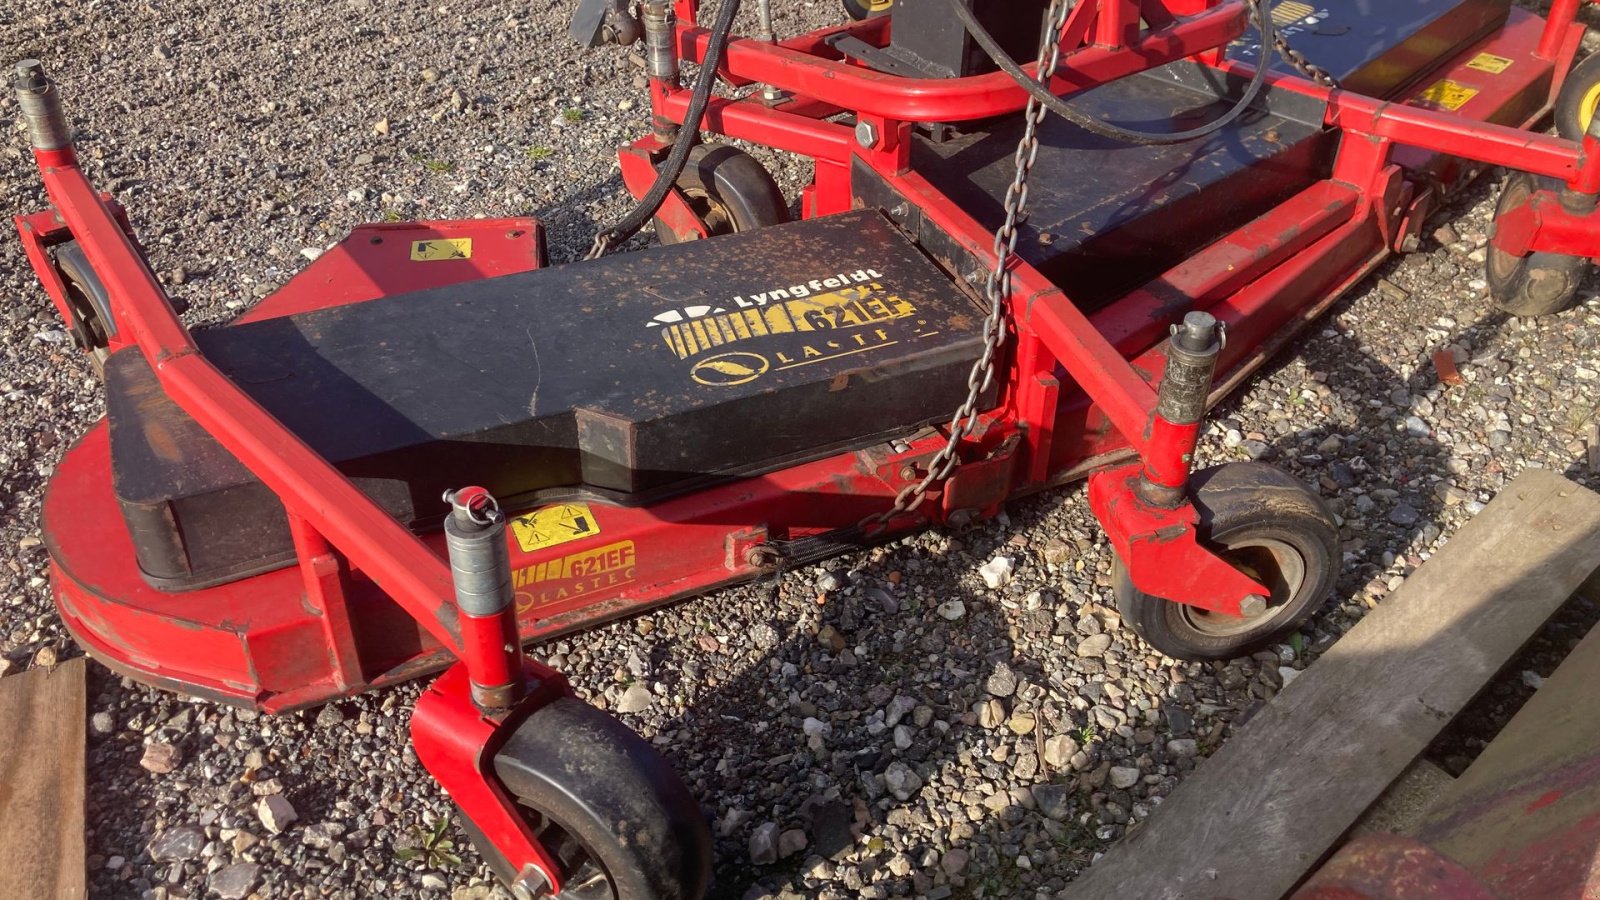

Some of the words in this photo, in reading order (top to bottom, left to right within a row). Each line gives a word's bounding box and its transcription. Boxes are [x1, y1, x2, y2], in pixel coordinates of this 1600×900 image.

[732, 268, 883, 308] Lyngfeldt
[803, 295, 908, 330] 621EF
[776, 328, 921, 363] LASTE
[570, 544, 634, 577] 621EF
[541, 567, 636, 603] LASTEC
